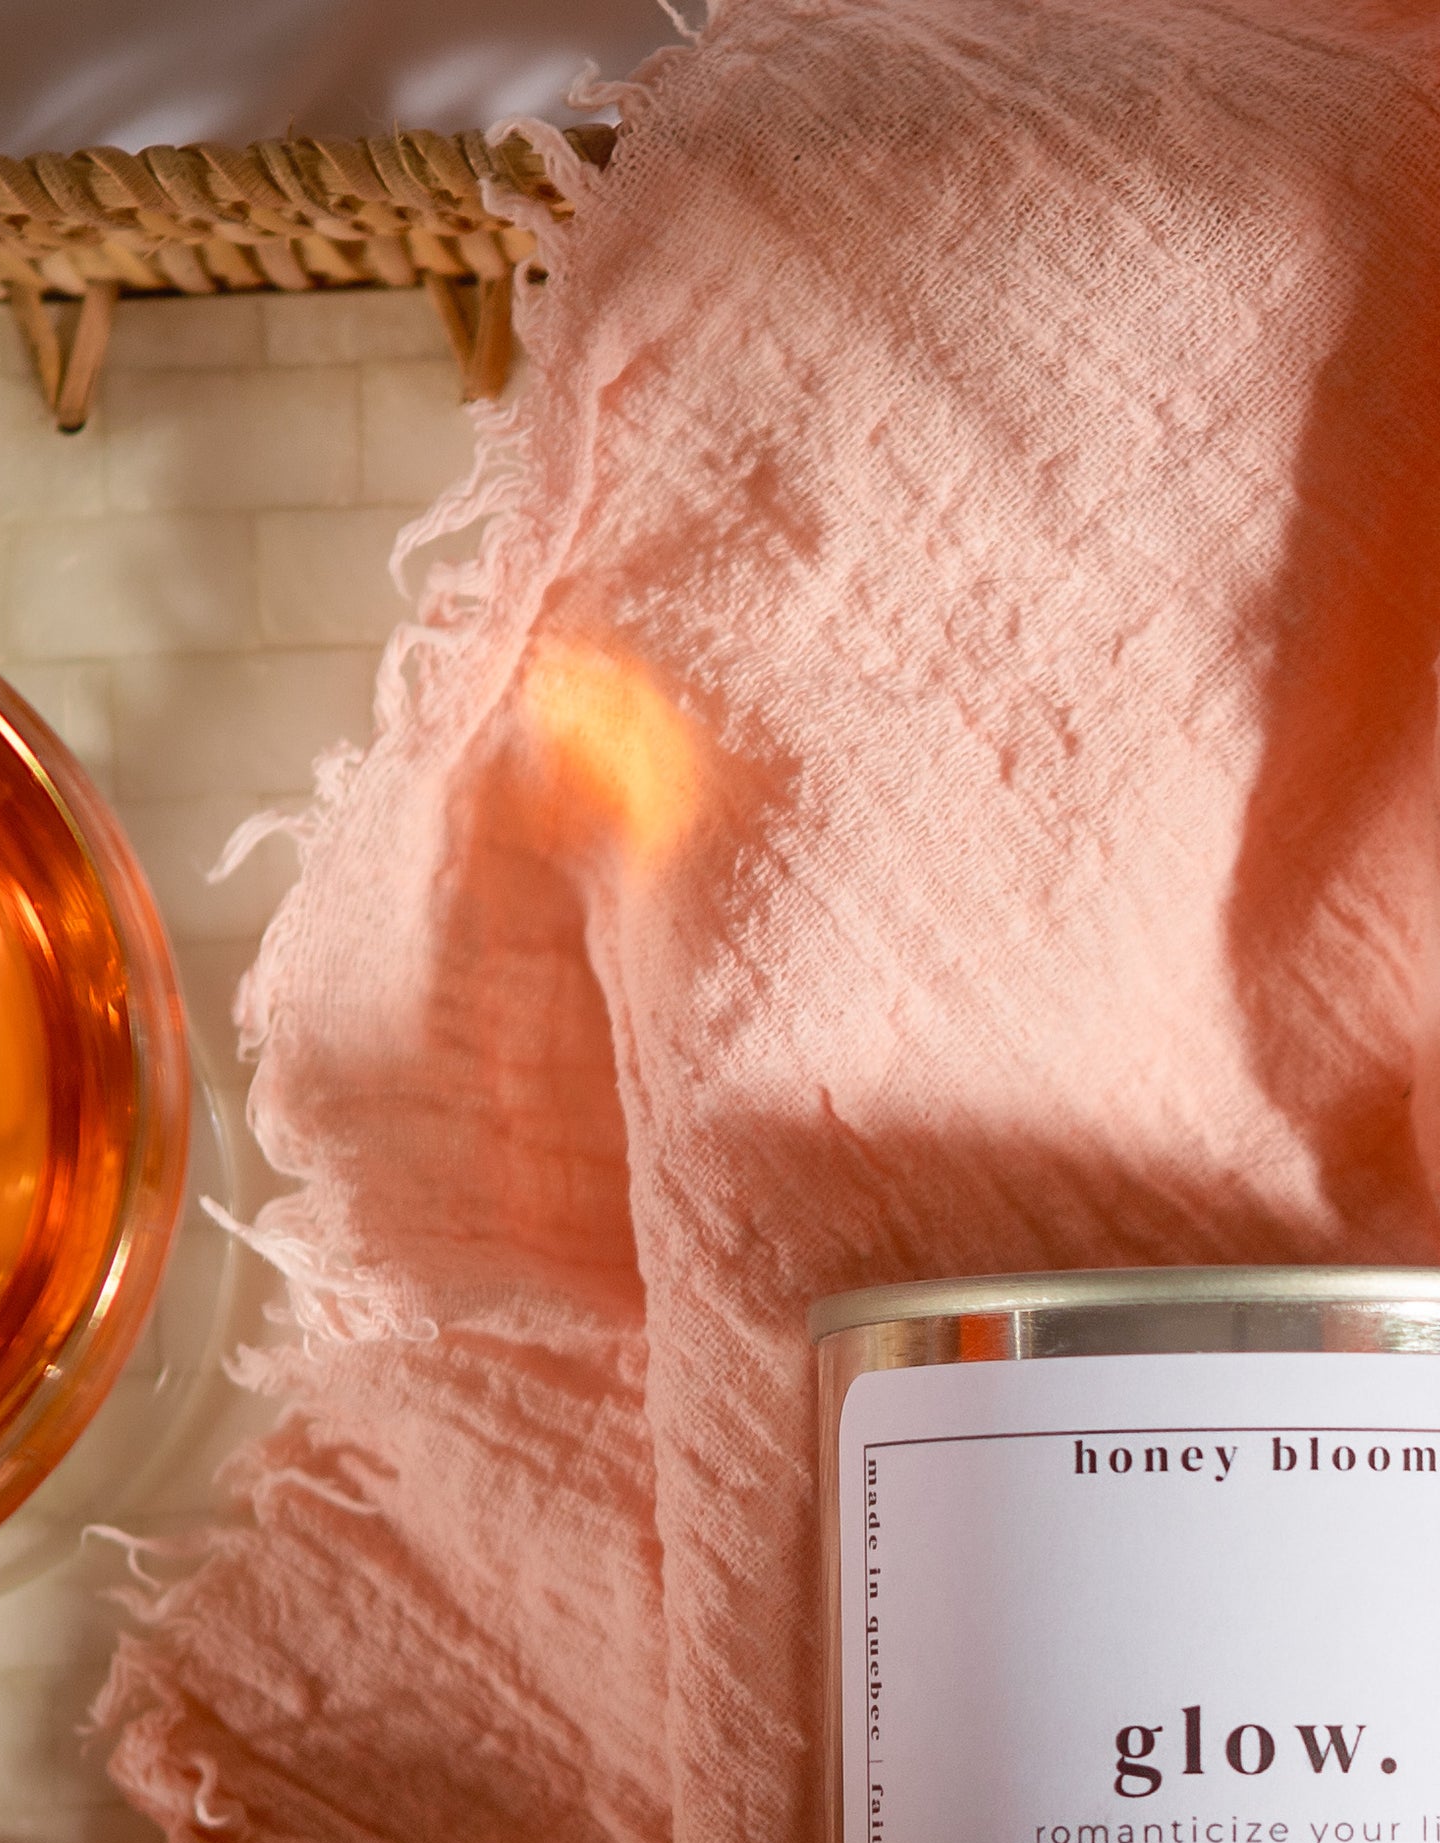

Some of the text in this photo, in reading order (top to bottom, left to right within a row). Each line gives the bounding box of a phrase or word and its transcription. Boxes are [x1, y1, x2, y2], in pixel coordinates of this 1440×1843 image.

[1074, 1437, 1439, 1484] honey bloom
[867, 1459, 881, 1551] made
[868, 1567, 882, 1600] in
[867, 1615, 883, 1742] quebec
[1114, 1705, 1399, 1800] glow.
[871, 1784, 884, 1843] fait
